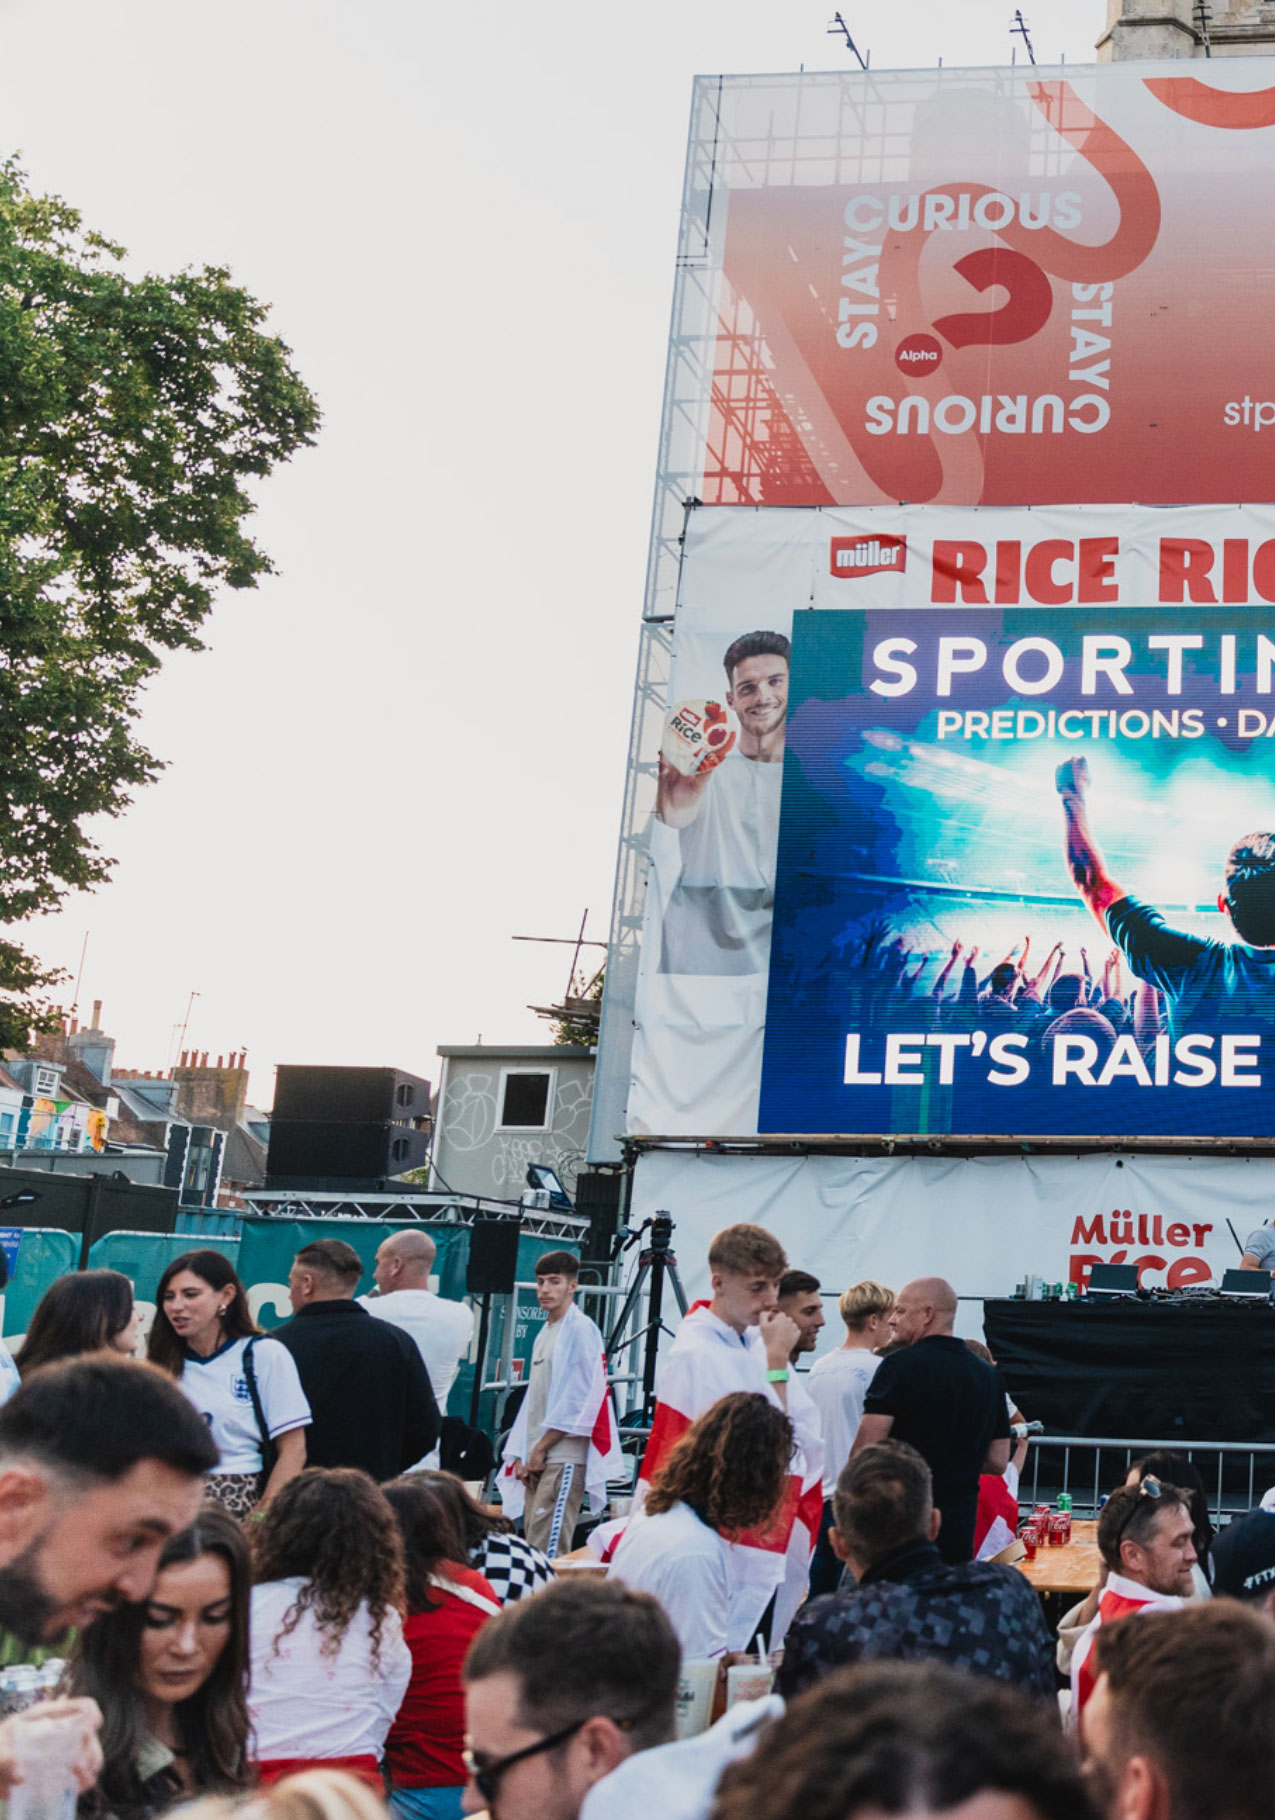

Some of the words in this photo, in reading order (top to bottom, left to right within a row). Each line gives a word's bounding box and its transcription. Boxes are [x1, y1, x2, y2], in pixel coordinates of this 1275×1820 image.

[843, 192, 1083, 232] CURIOUS
[836, 237, 883, 349] STAY
[1068, 281, 1114, 390] STAY
[899, 349, 938, 362] Alpha
[864, 394, 1111, 436] CURIOUS
[836, 543, 900, 568] müller
[931, 536, 1119, 605] RICE
[670, 716, 702, 743] Rice
[936, 709, 1205, 740] PREDICTIONS
[843, 1030, 1031, 1087] LET'S
[1052, 1033, 1262, 1087] RAISE
[1070, 1209, 1213, 1248] Müller
[516, 1325, 528, 1338] BY
